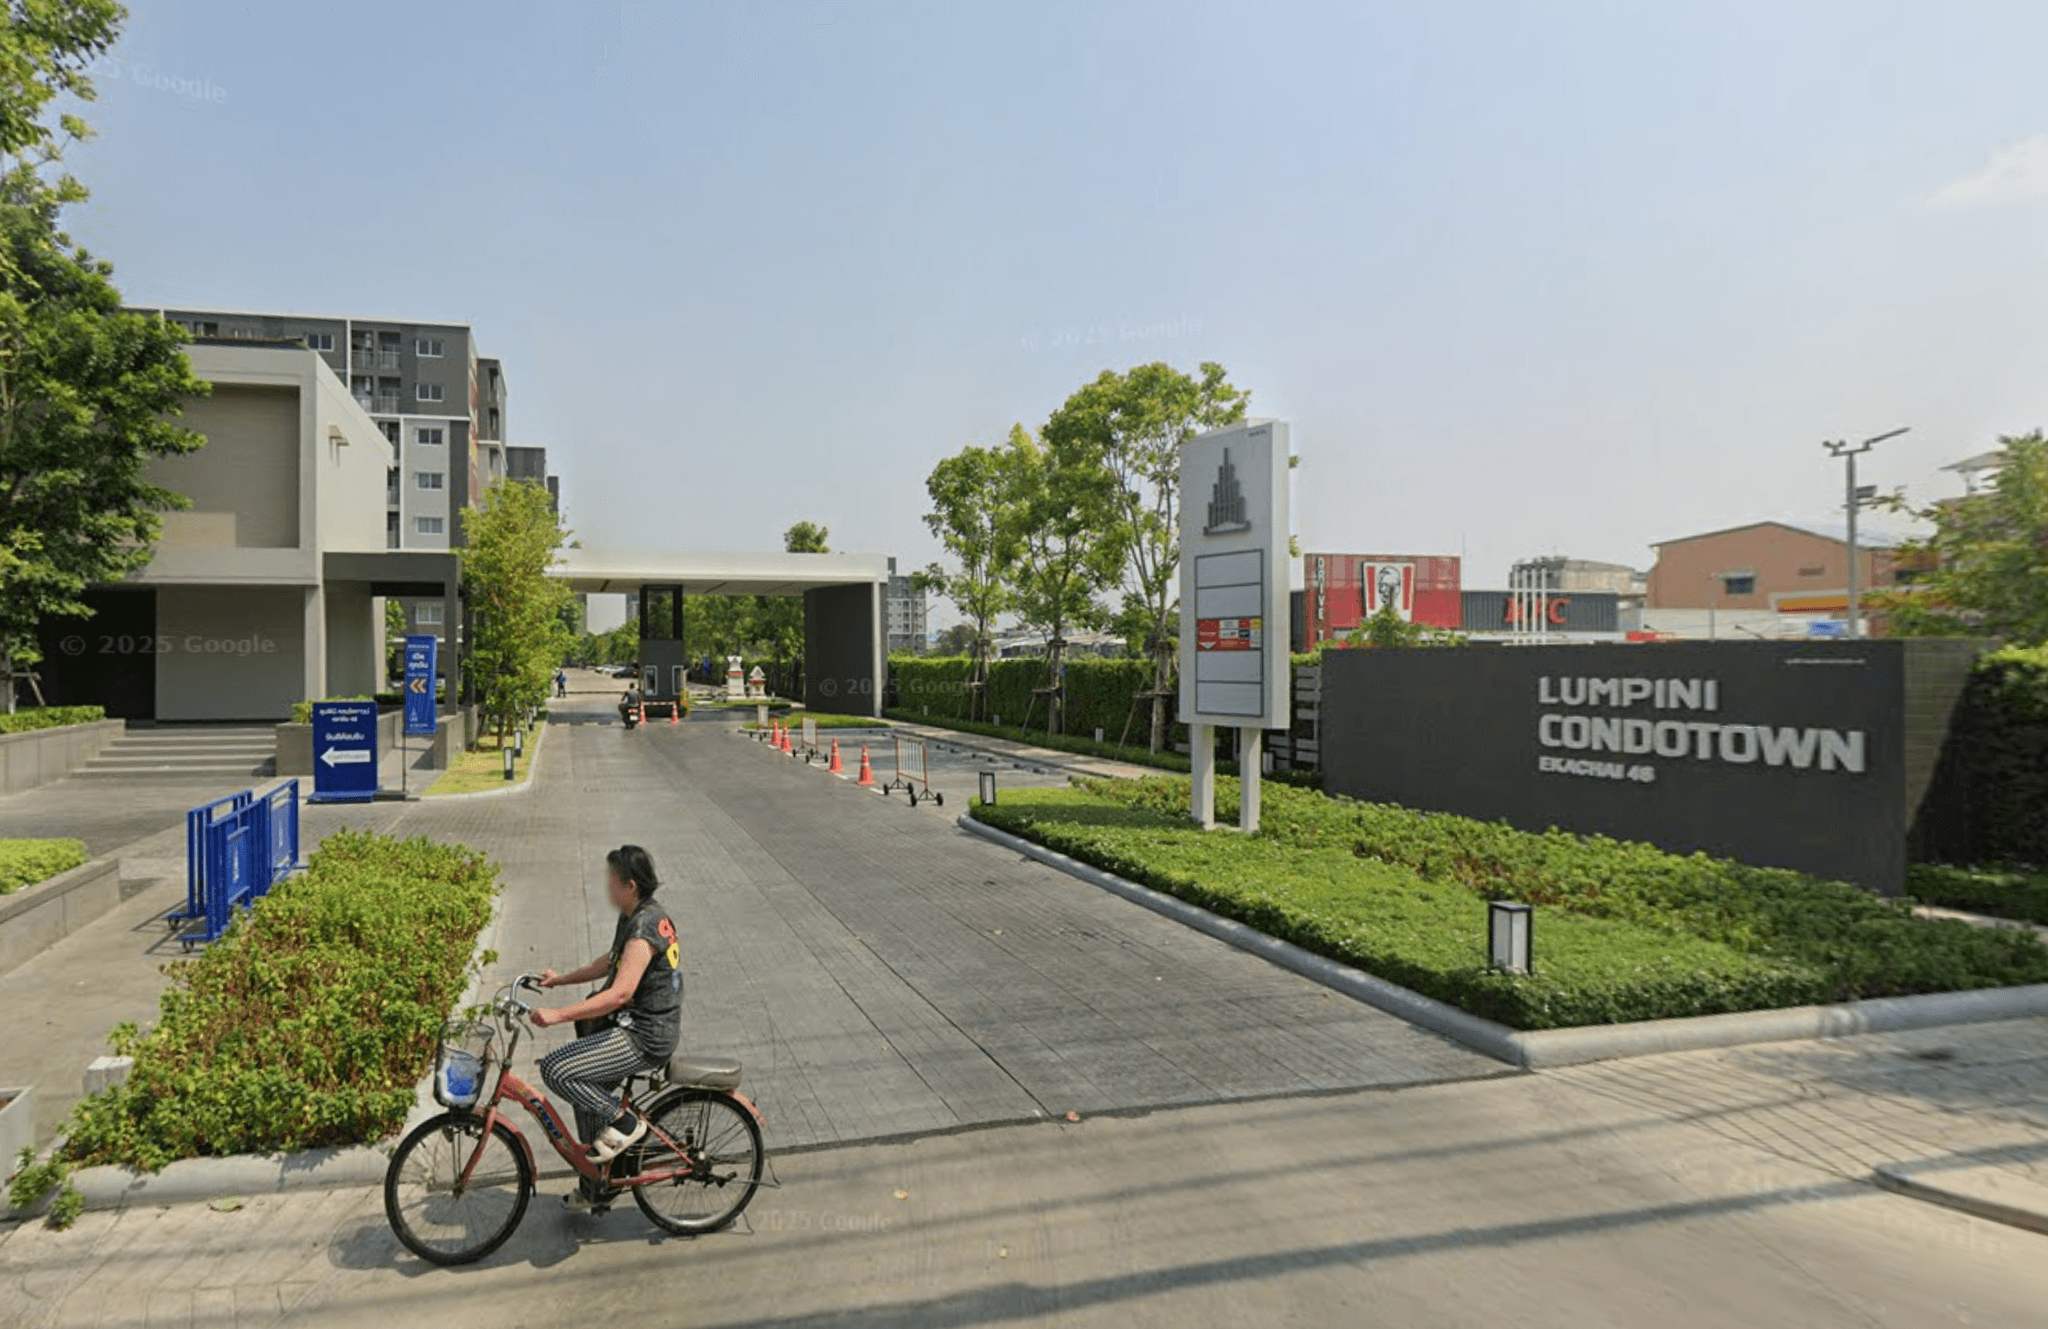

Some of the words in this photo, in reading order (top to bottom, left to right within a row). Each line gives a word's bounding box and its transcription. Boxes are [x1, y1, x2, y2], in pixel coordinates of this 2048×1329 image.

[1538, 676, 1719, 711] LUMPINI
[1538, 714, 1865, 773] CONDOTOWN
[1538, 755, 1625, 779] EKACHAI
